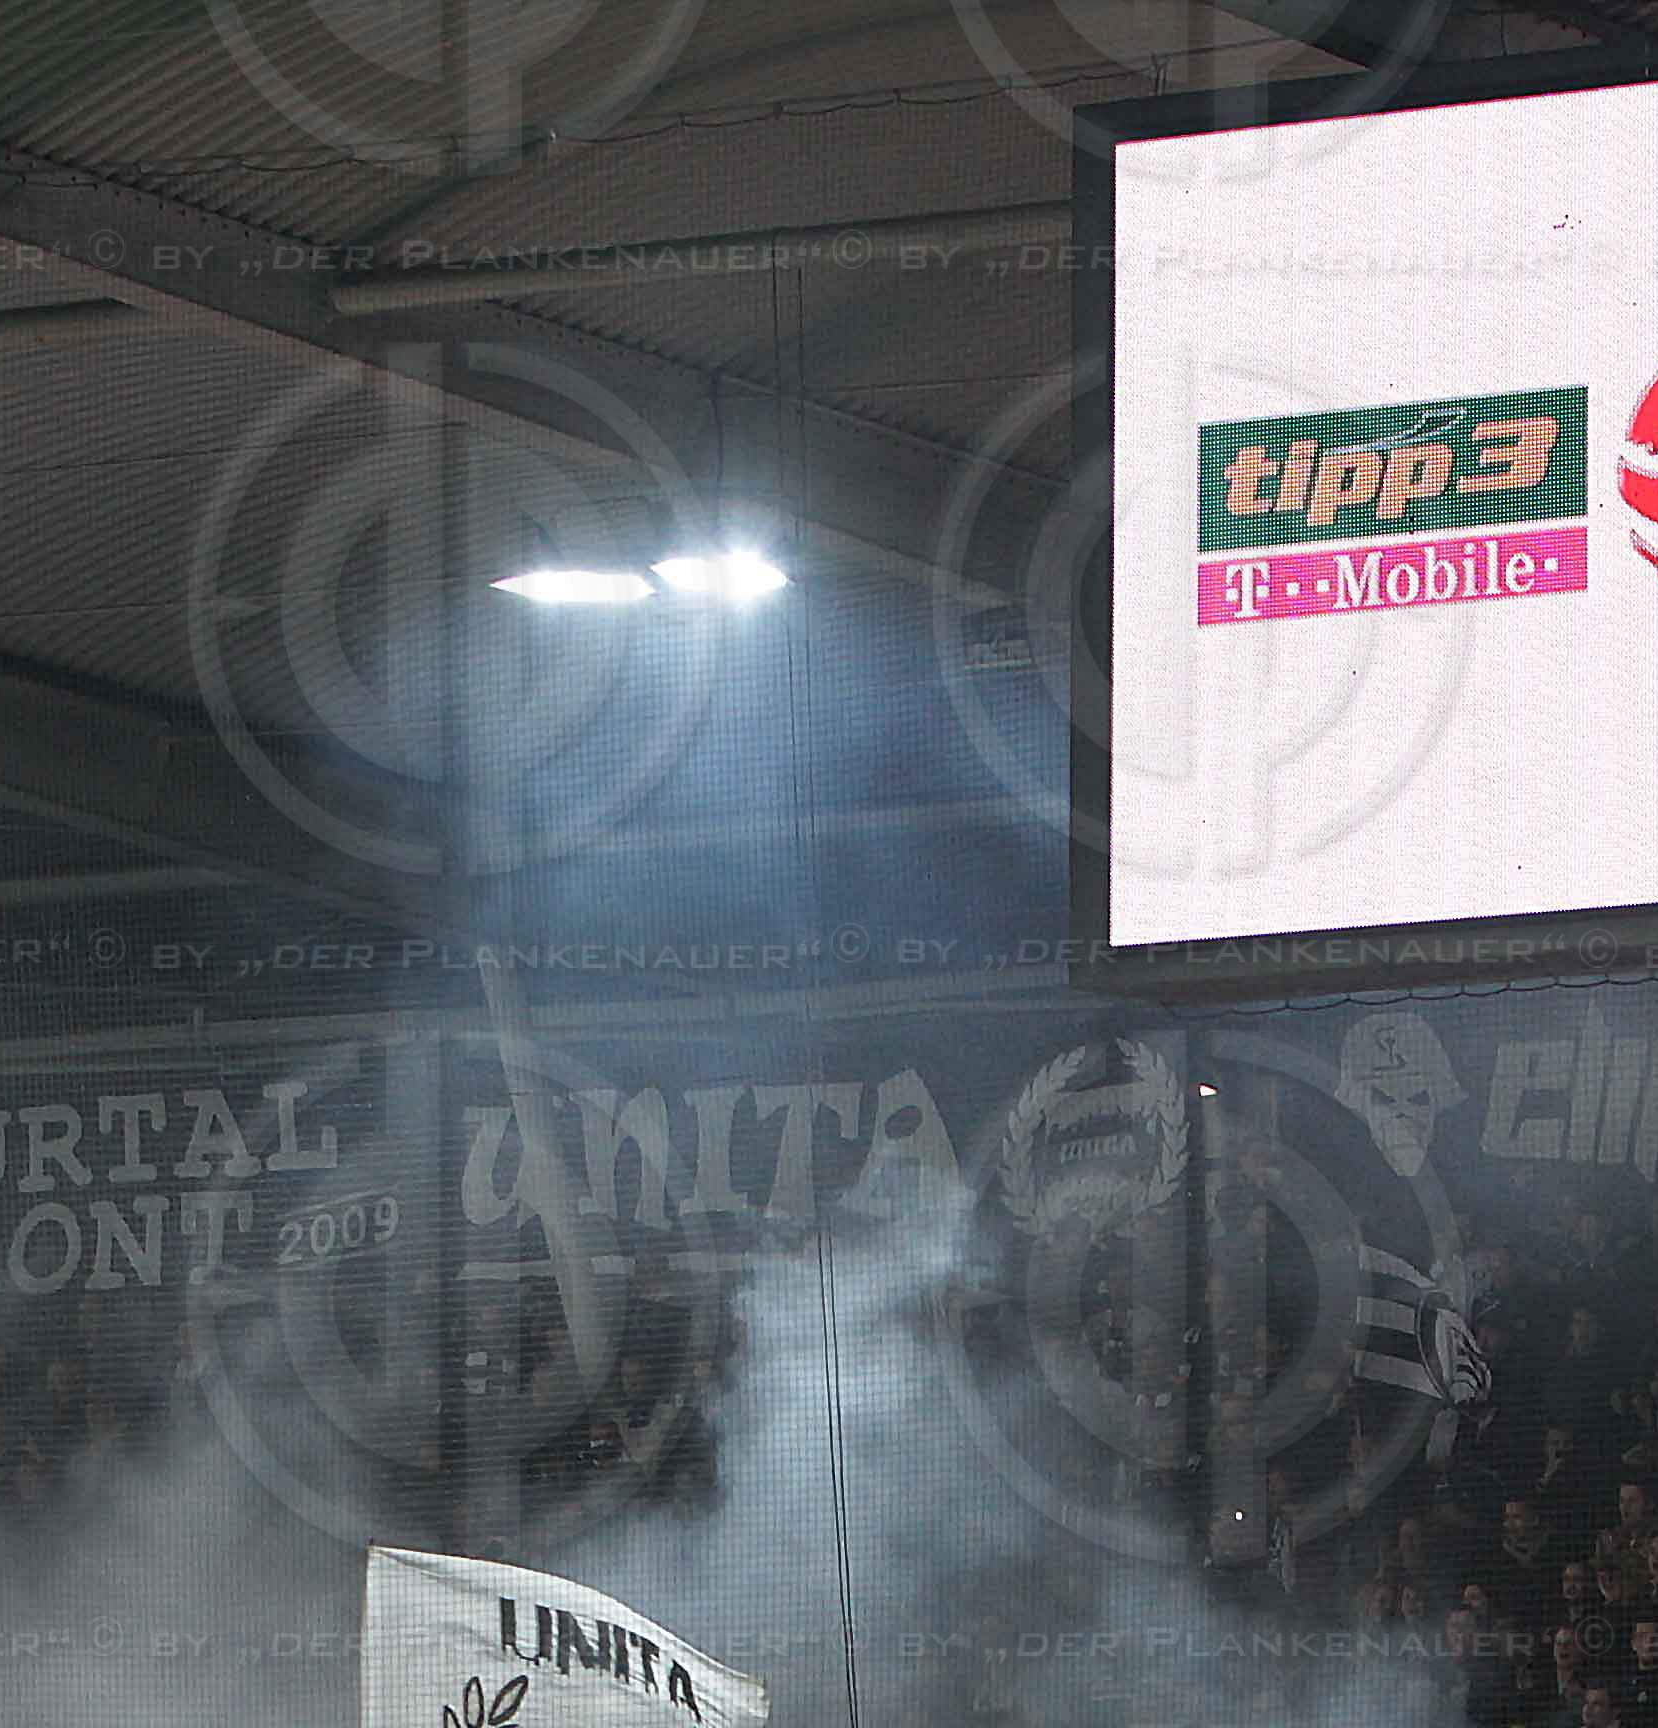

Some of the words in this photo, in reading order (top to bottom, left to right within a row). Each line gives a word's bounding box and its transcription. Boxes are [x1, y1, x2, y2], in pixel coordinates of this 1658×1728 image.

[1222, 405, 1562, 528] tipp3
[277, 1195, 402, 1266] 2009
[497, 1595, 705, 1724] UNITA
